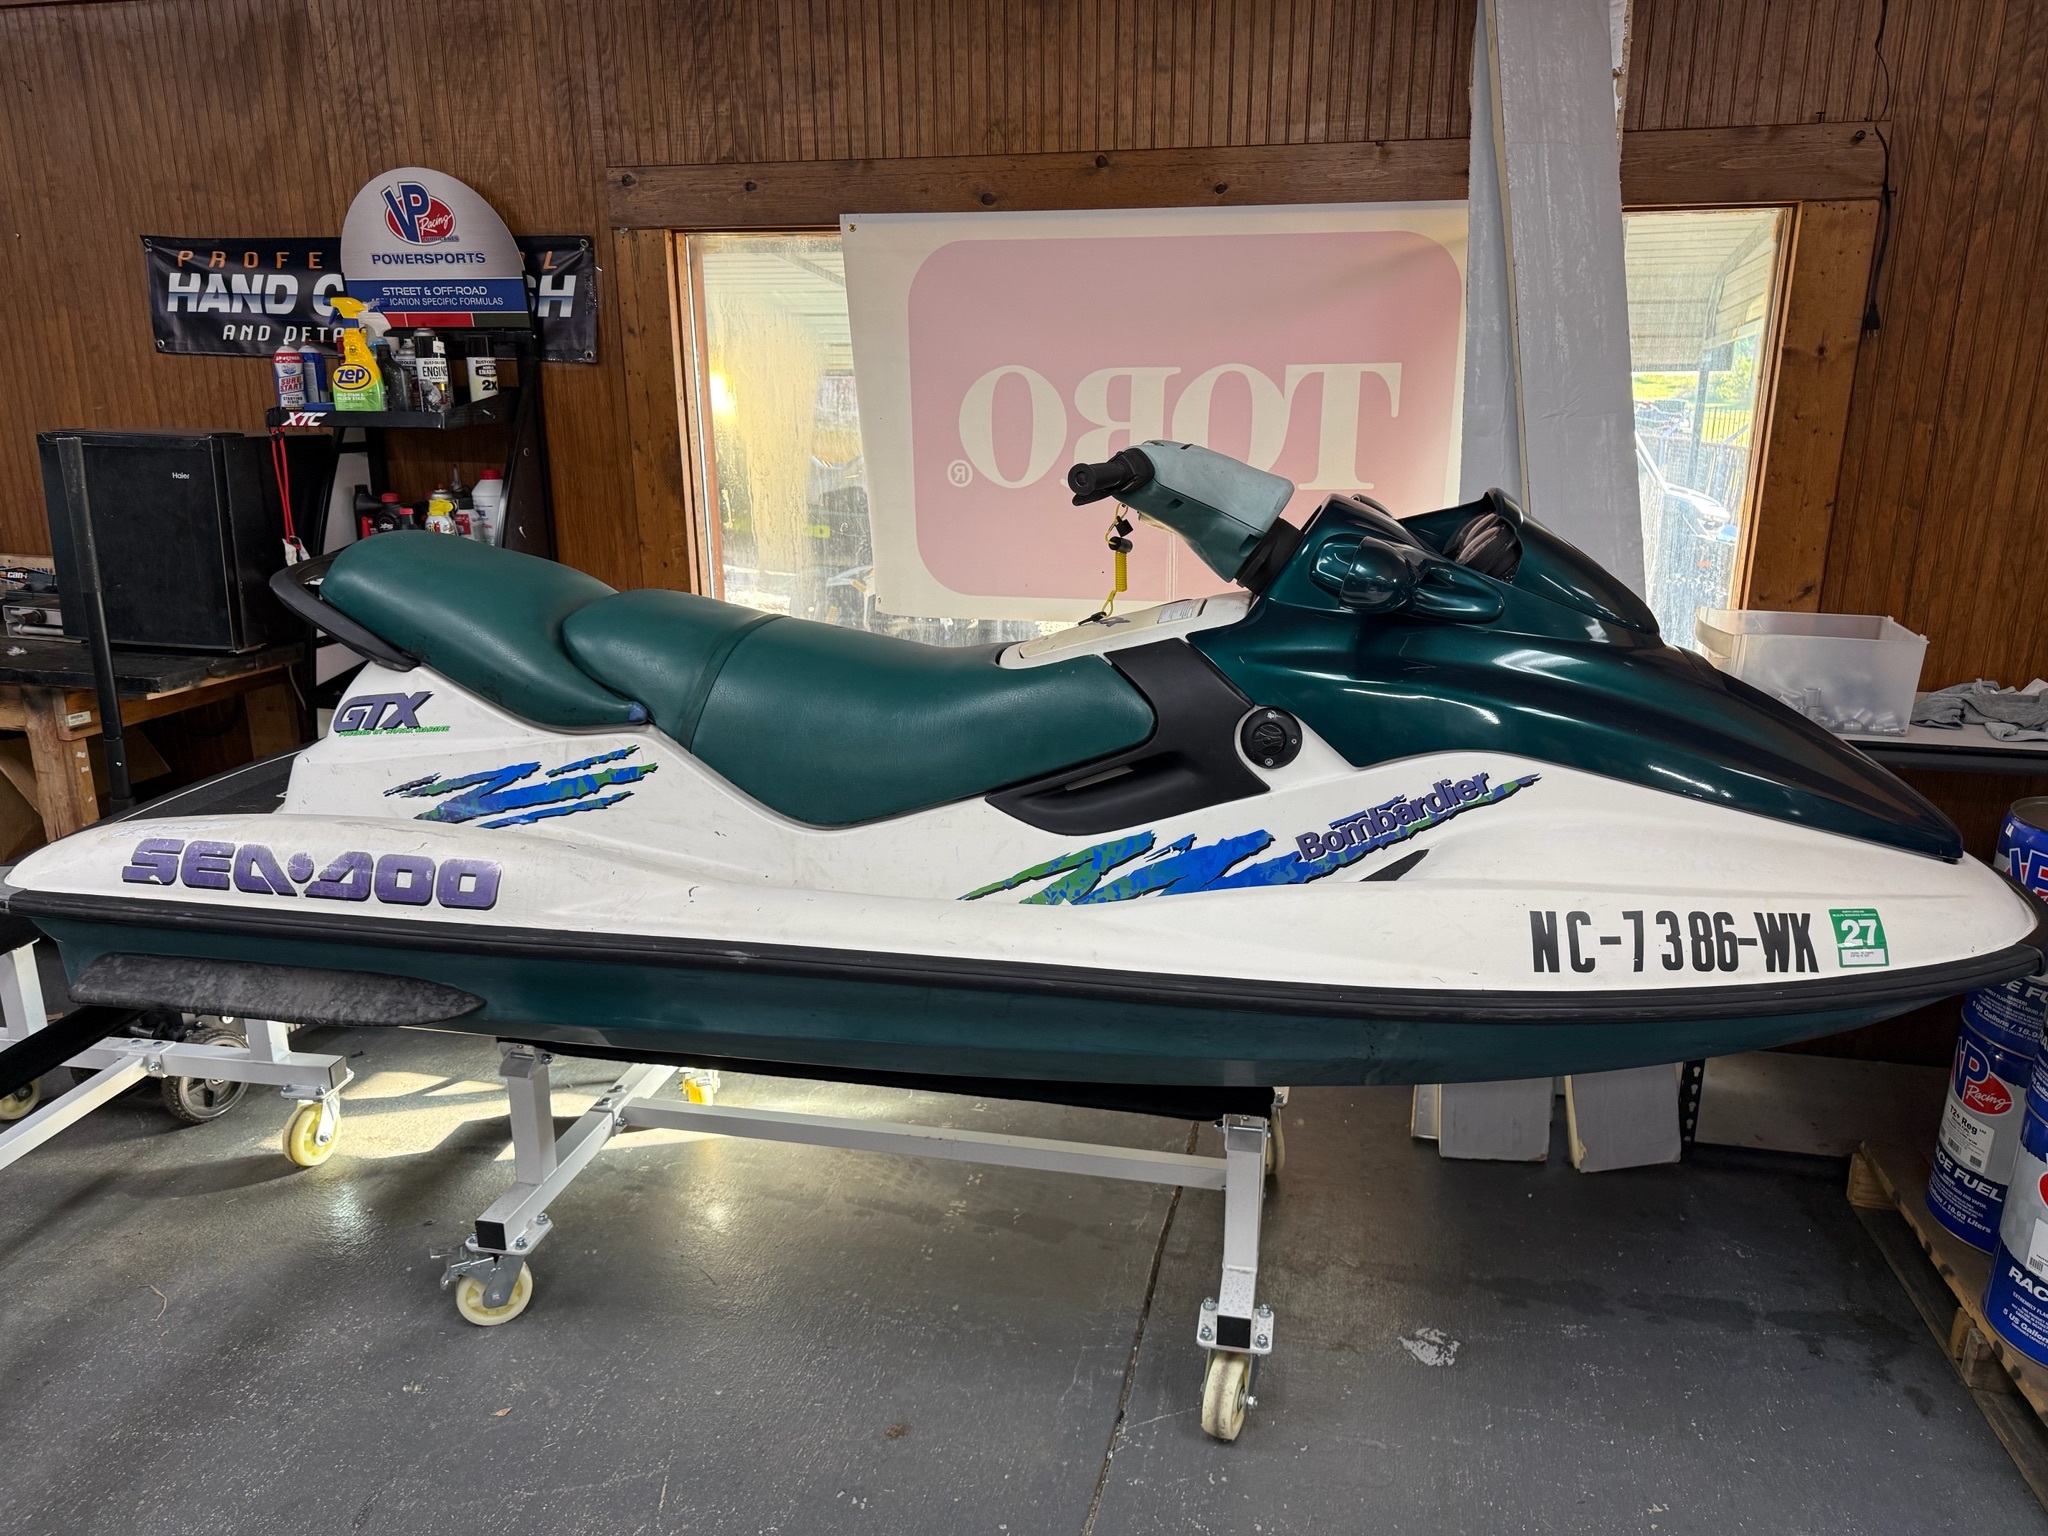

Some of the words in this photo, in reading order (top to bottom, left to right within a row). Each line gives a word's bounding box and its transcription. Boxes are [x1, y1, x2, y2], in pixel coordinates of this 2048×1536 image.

[381, 181, 431, 244] VP
[419, 213, 453, 236] Racing
[371, 252, 486, 265] POWERSPORTS
[167, 272, 299, 315] HAND
[382, 286, 423, 296] STREET
[424, 286, 431, 296] &
[432, 286, 487, 296] OFF-ROAD
[422, 297, 457, 306] SPECIFIC
[459, 297, 504, 306] FORMULAS
[222, 324, 271, 341] AND
[281, 376, 301, 386] SURE
[422, 366, 448, 377] ENGINE
[280, 383, 302, 392] START
[281, 412, 327, 426] XTC
[171, 471, 190, 479] Haier
[333, 690, 435, 733] GTX
[1295, 771, 1492, 863] Bombardier
[1840, 919, 1877, 946] 27
[1984, 1009, 2009, 1027] Gallons
[1966, 1084, 2012, 1111] Racing
[1961, 1117, 1978, 1136] Reg
[1953, 1167, 2003, 1203] FUEL
[1947, 1205, 1966, 1221] 18.93
[1967, 1217, 1991, 1234] Liters
[2009, 1265, 2048, 1302] RAC
[2009, 1313, 2020, 1326] US
[2020, 1321, 2048, 1343] Gallon
